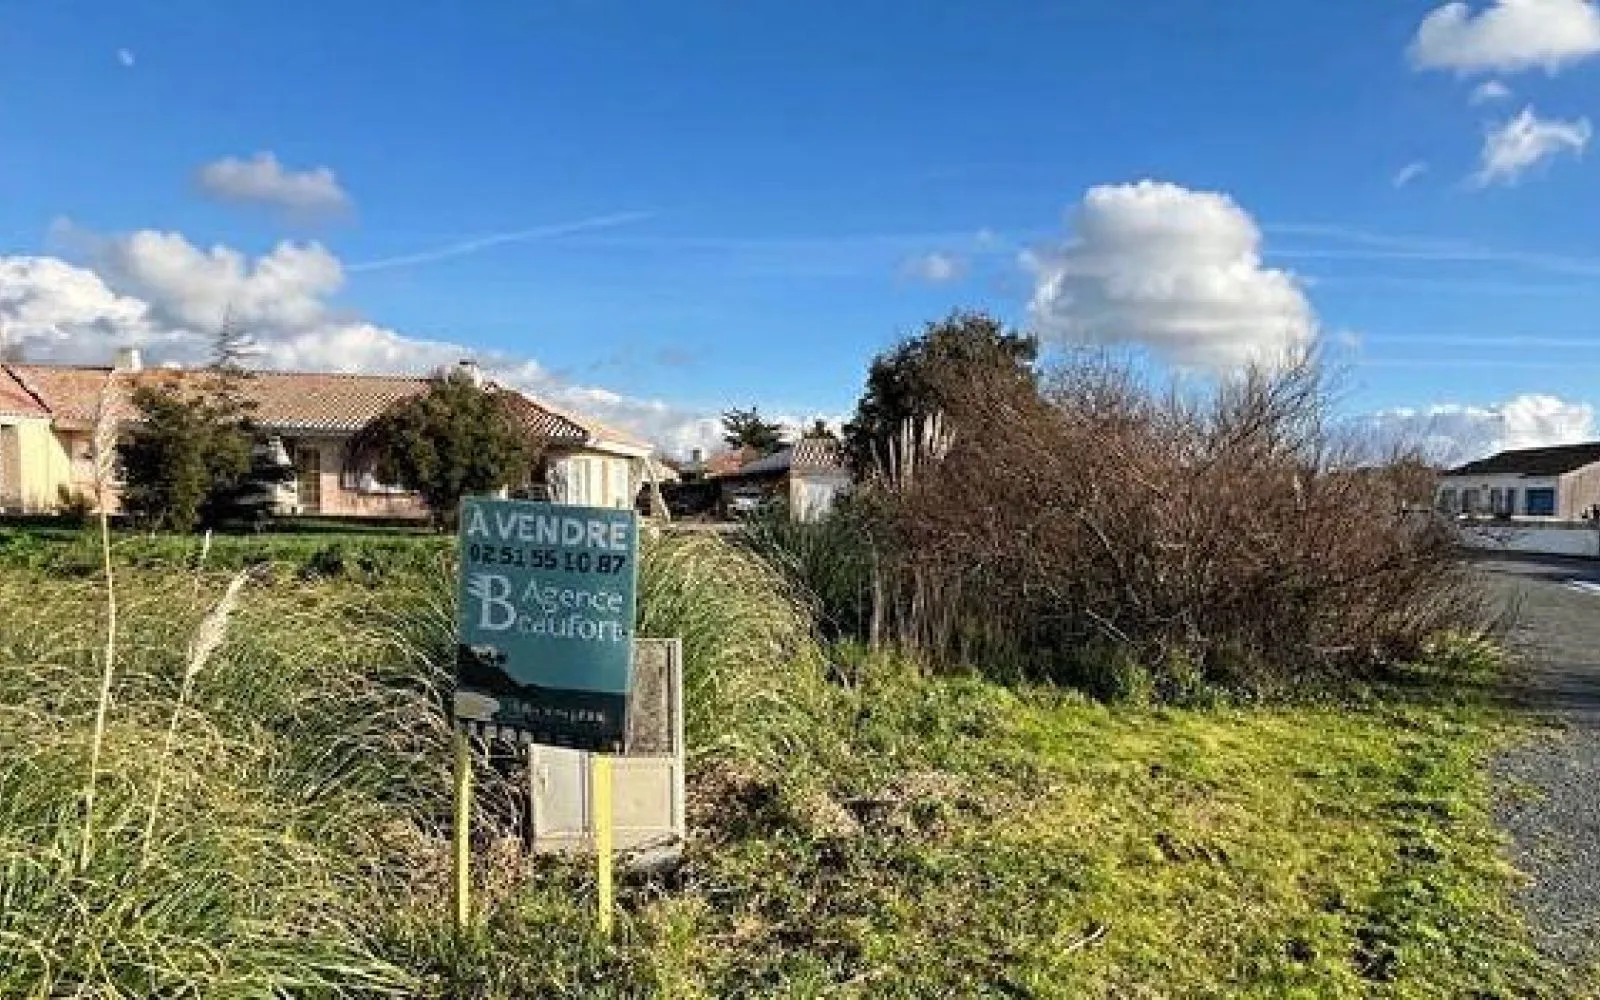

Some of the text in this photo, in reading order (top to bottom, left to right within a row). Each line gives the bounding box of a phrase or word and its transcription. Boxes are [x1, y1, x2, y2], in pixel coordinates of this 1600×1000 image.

[496, 512, 628, 550] VENDRE
[470, 543, 626, 574] 02 51 55 10 87
[522, 577, 623, 614] Agence
